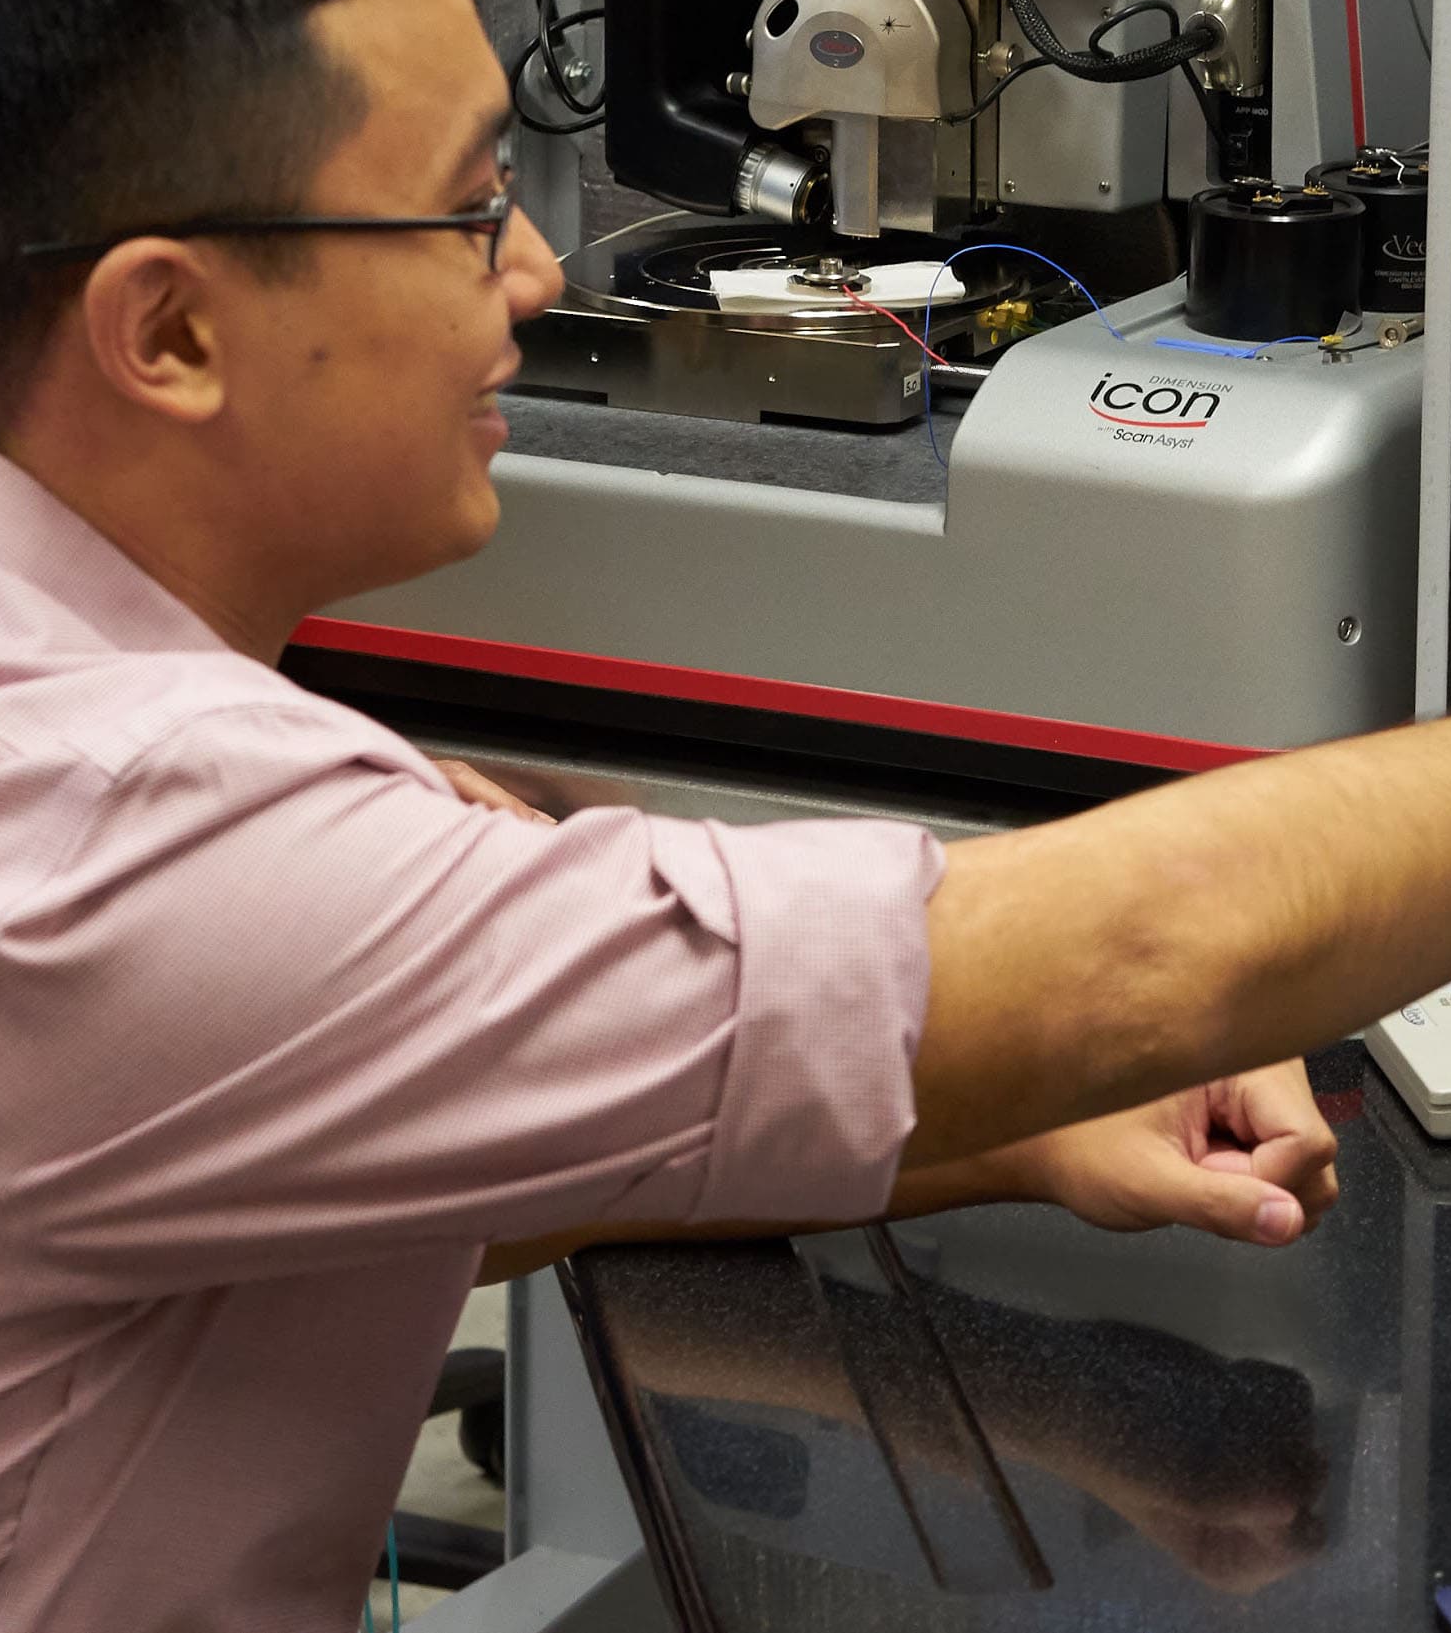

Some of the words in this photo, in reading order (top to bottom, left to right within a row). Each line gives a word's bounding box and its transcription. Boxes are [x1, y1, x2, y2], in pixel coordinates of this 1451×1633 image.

[1149, 375, 1234, 393] DIMENSION
[1090, 372, 1221, 419] icon
[1113, 428, 1194, 450] ScanAsyst
